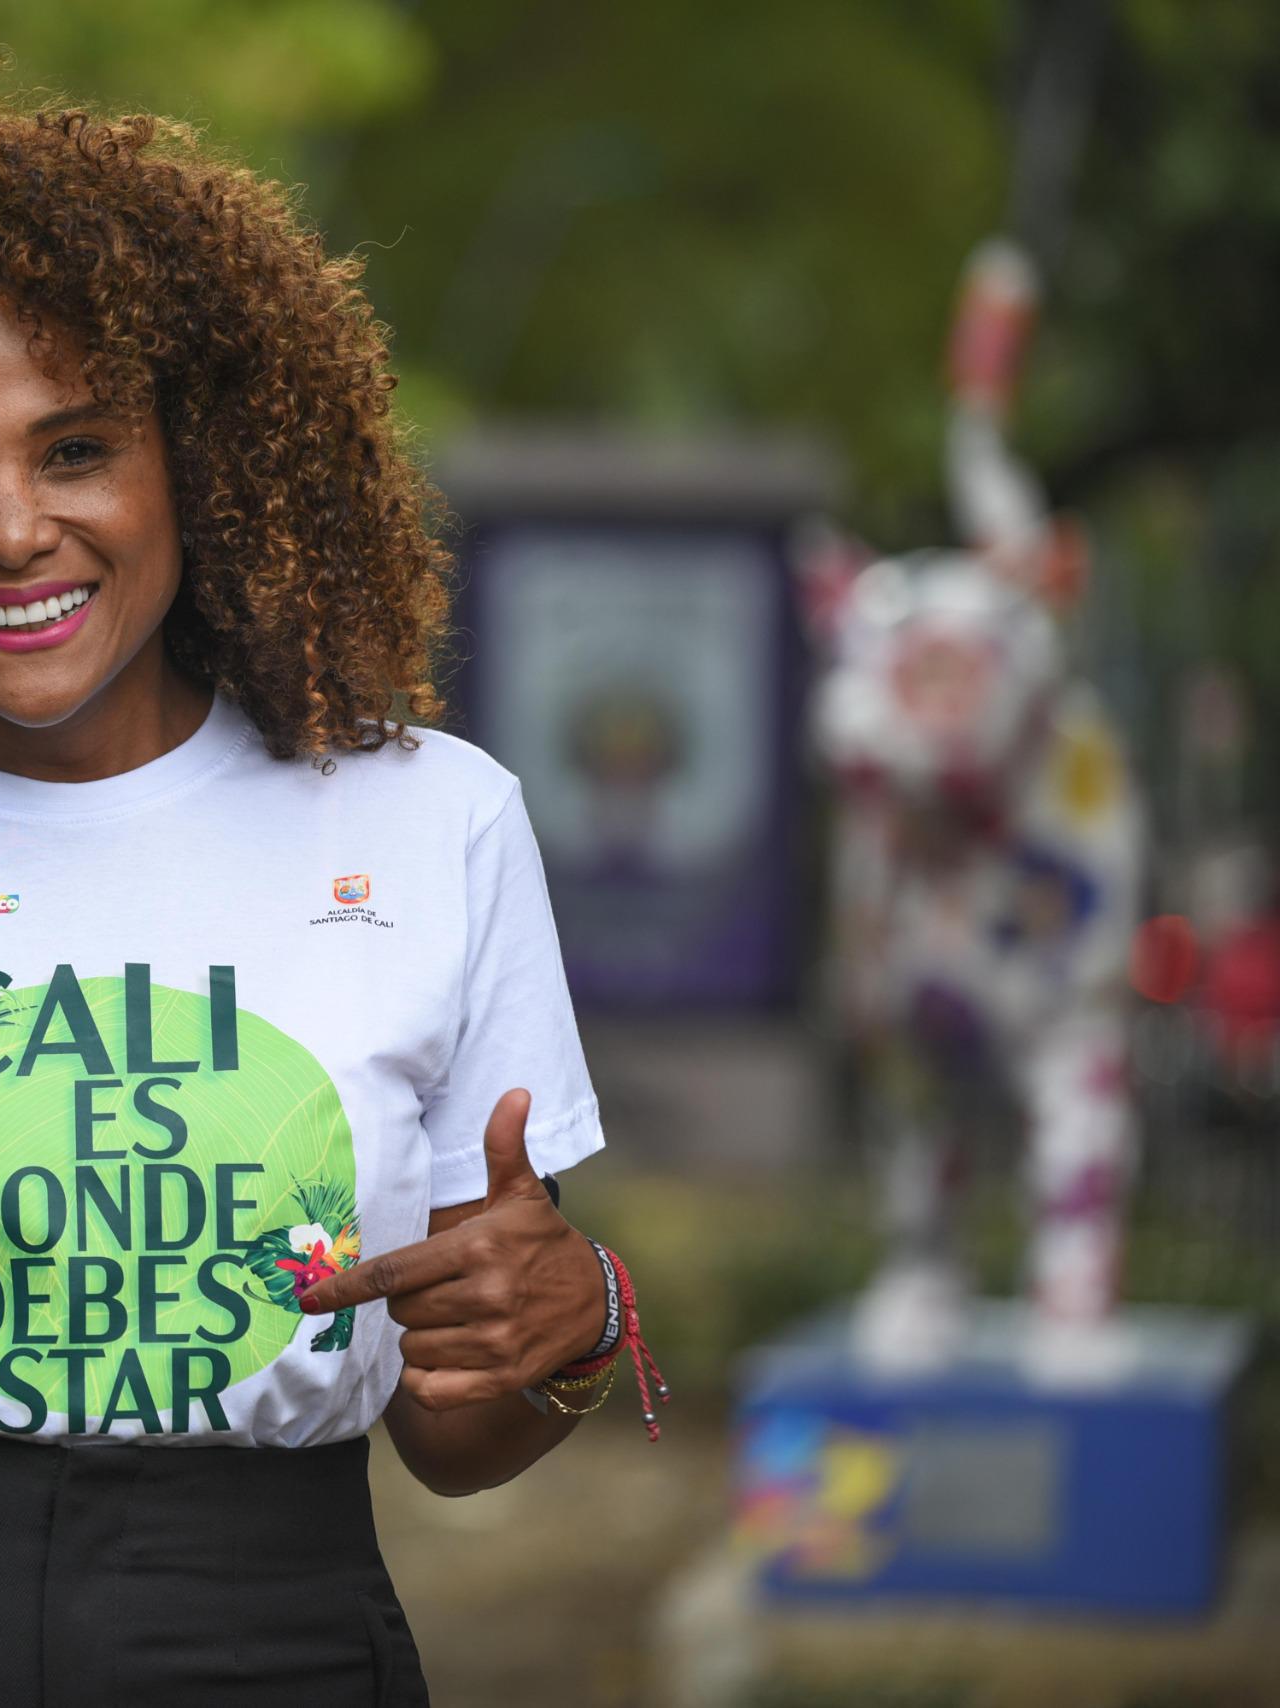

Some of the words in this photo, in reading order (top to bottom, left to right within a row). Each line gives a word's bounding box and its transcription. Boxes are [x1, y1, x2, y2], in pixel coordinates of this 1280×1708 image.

[310, 915, 357, 925] SANTIAGO
[362, 915, 372, 924] DE
[374, 919, 394, 928] CALI
[74, 1077, 189, 1161] ES
